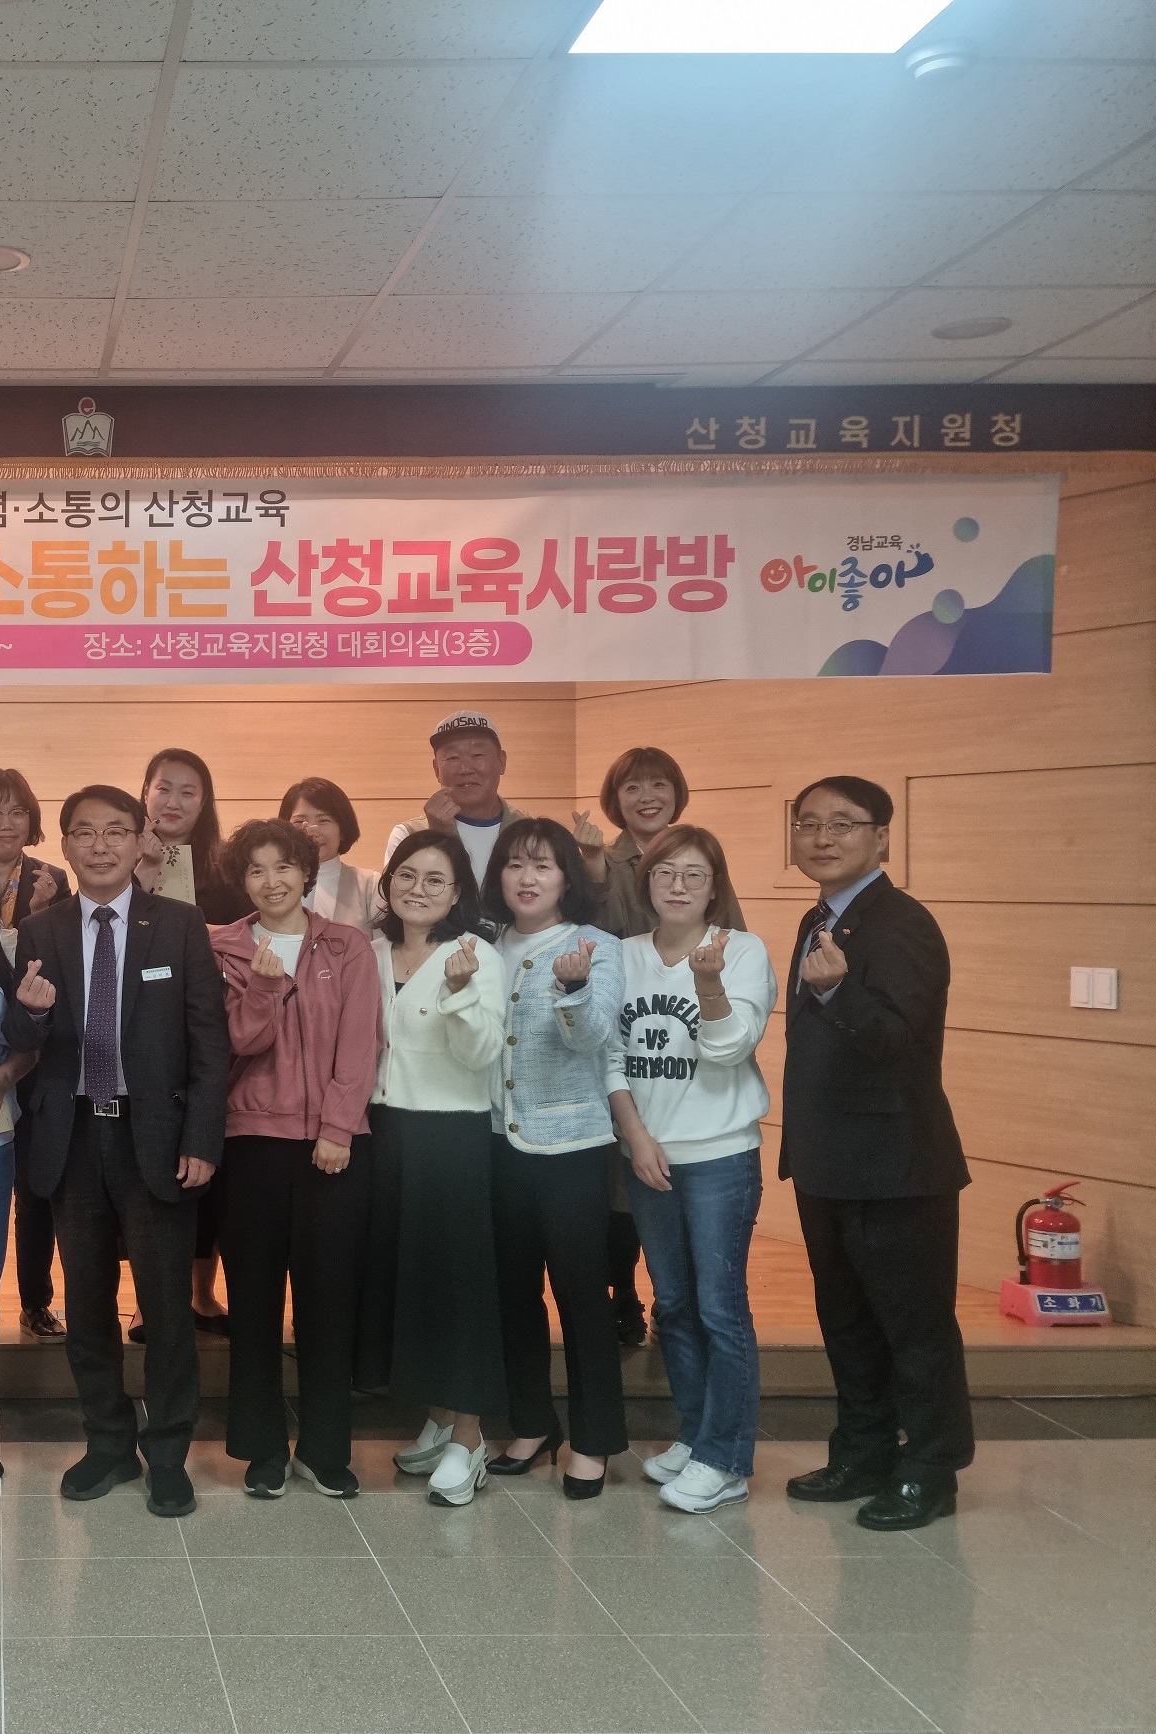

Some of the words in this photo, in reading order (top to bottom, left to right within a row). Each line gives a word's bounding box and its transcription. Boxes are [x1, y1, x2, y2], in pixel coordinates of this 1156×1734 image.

[686, 413, 1022, 450] 산청교육지원청
[143, 489, 290, 528] 산청교육
[846, 534, 903, 551] 경남교육
[250, 534, 736, 617] 산청교육사랑방
[760, 551, 935, 612] 아이좋아
[83, 632, 142, 658] 장소:
[149, 631, 329, 660] 산청교육지원청
[337, 630, 501, 658] 대회의실(3층)
[438, 716, 488, 732] DINOSAUR
[1044, 1295, 1102, 1310] 소화기
